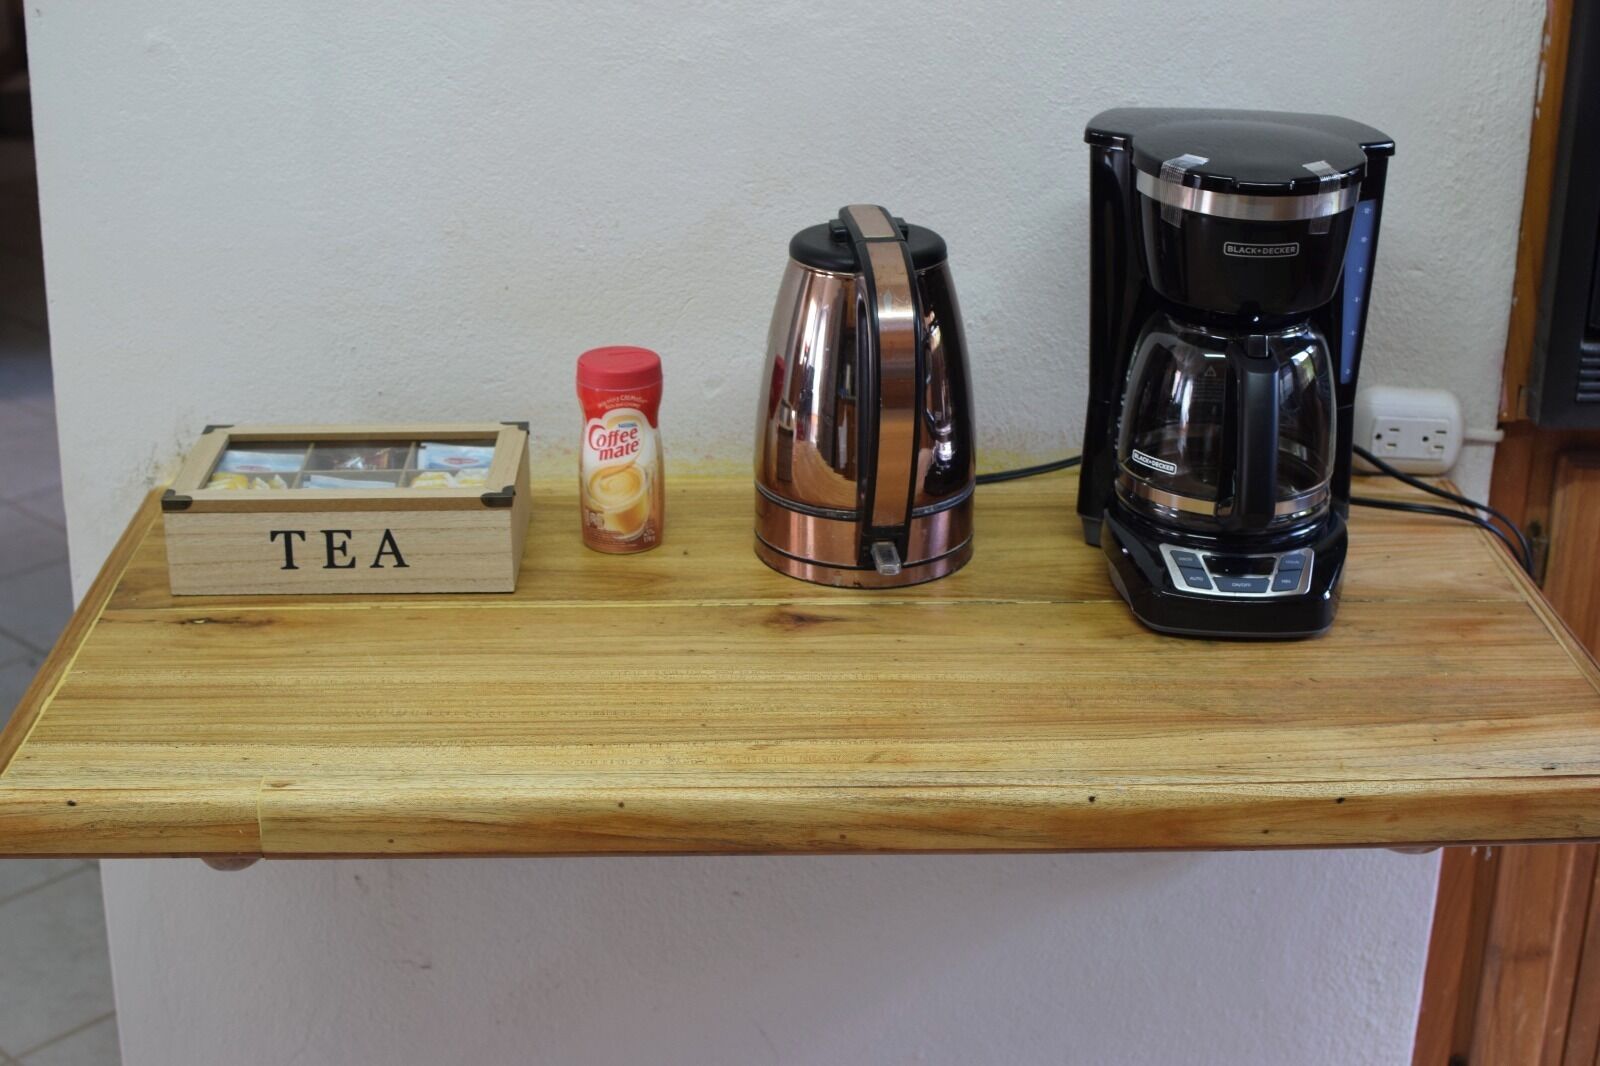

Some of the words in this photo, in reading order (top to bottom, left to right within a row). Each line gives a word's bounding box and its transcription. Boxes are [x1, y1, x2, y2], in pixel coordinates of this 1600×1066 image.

[588, 424, 639, 451] Coffee
[598, 440, 640, 461] mate
[270, 528, 410, 570] TEA
